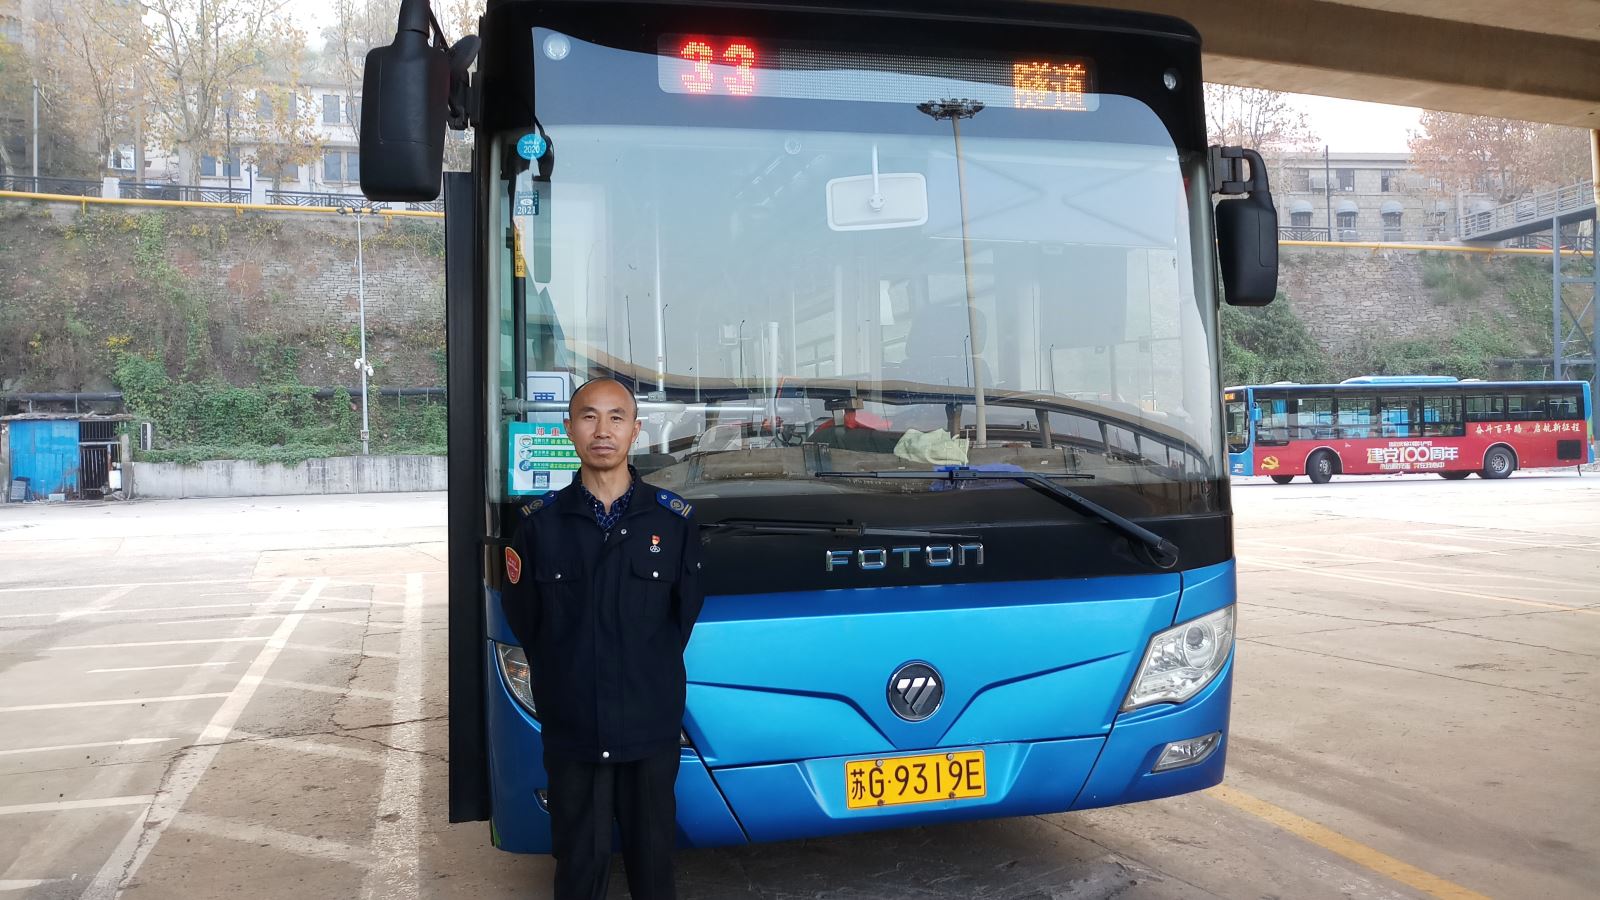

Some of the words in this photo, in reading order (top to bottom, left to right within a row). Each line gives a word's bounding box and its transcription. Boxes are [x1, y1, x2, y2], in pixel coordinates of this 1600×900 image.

[681, 42, 755, 95] 33
[523, 145, 541, 154] 2020
[517, 206, 536, 215] 2021
[1475, 423, 1522, 434] 奋斗百年路
[1533, 422, 1581, 433] 启航新征程
[1366, 447, 1459, 463] 建党100周年
[826, 543, 984, 572] FOTON
